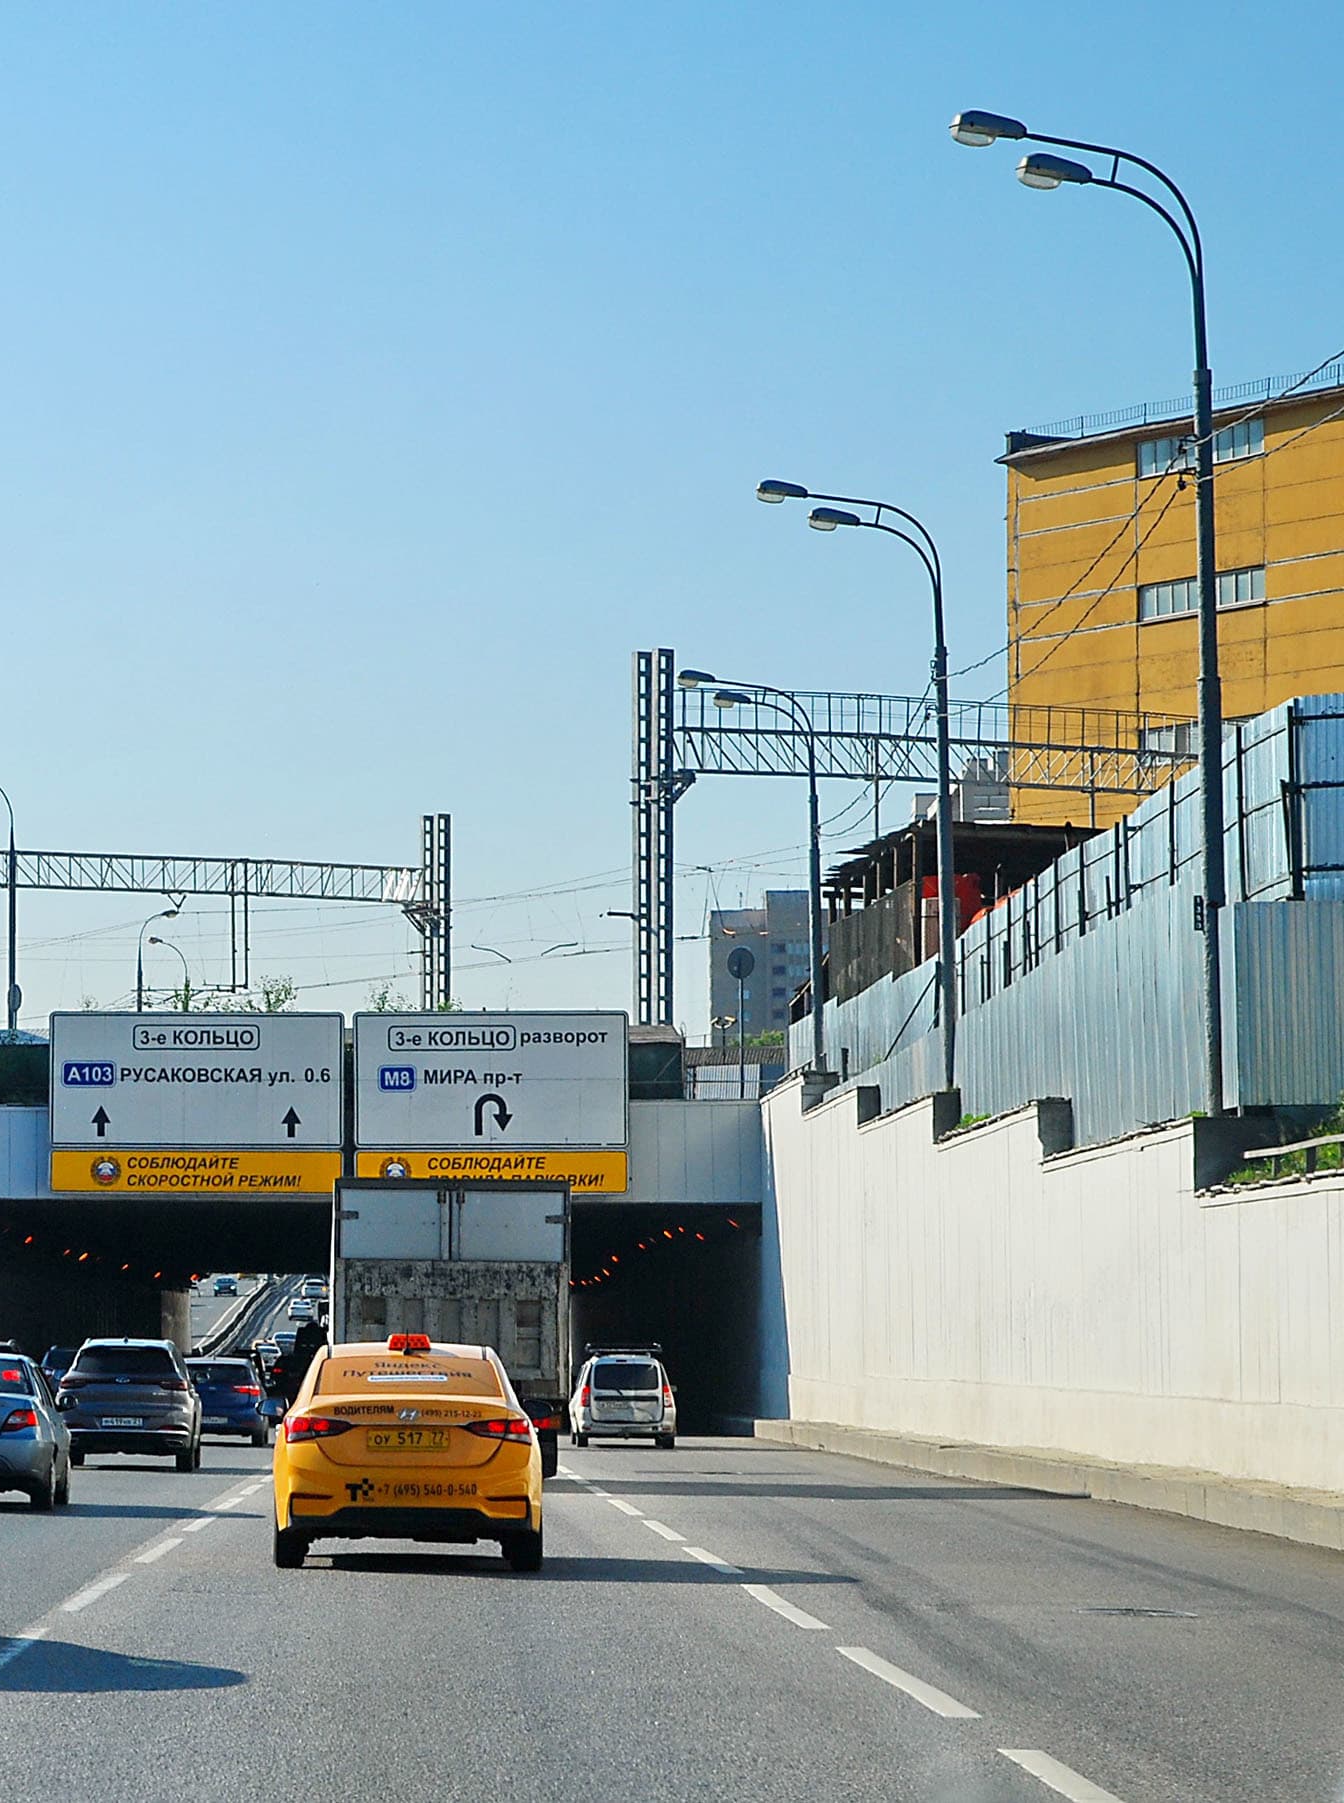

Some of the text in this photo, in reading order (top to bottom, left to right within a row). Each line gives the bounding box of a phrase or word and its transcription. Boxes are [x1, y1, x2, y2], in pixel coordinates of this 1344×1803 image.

[140, 1030, 254, 1047] 3-е КОЛЬЦО
[395, 1031, 608, 1048] 3-е КОЛЬЦО разворот
[67, 1066, 113, 1082] А103
[120, 1067, 331, 1086] РУСАКОВСКАЯ ул. 0.6
[384, 1070, 412, 1086] М8
[423, 1069, 523, 1088] МИРА пр-т
[127, 1155, 240, 1172] СОБЛЮДАЙТЕ
[428, 1155, 546, 1172] СОБЛЮДАЙТЕ
[127, 1173, 301, 1187] СКОРОСТНОЙ РЕЖИМ!
[334, 1405, 395, 1416] ВОДИТЕЛЯМ
